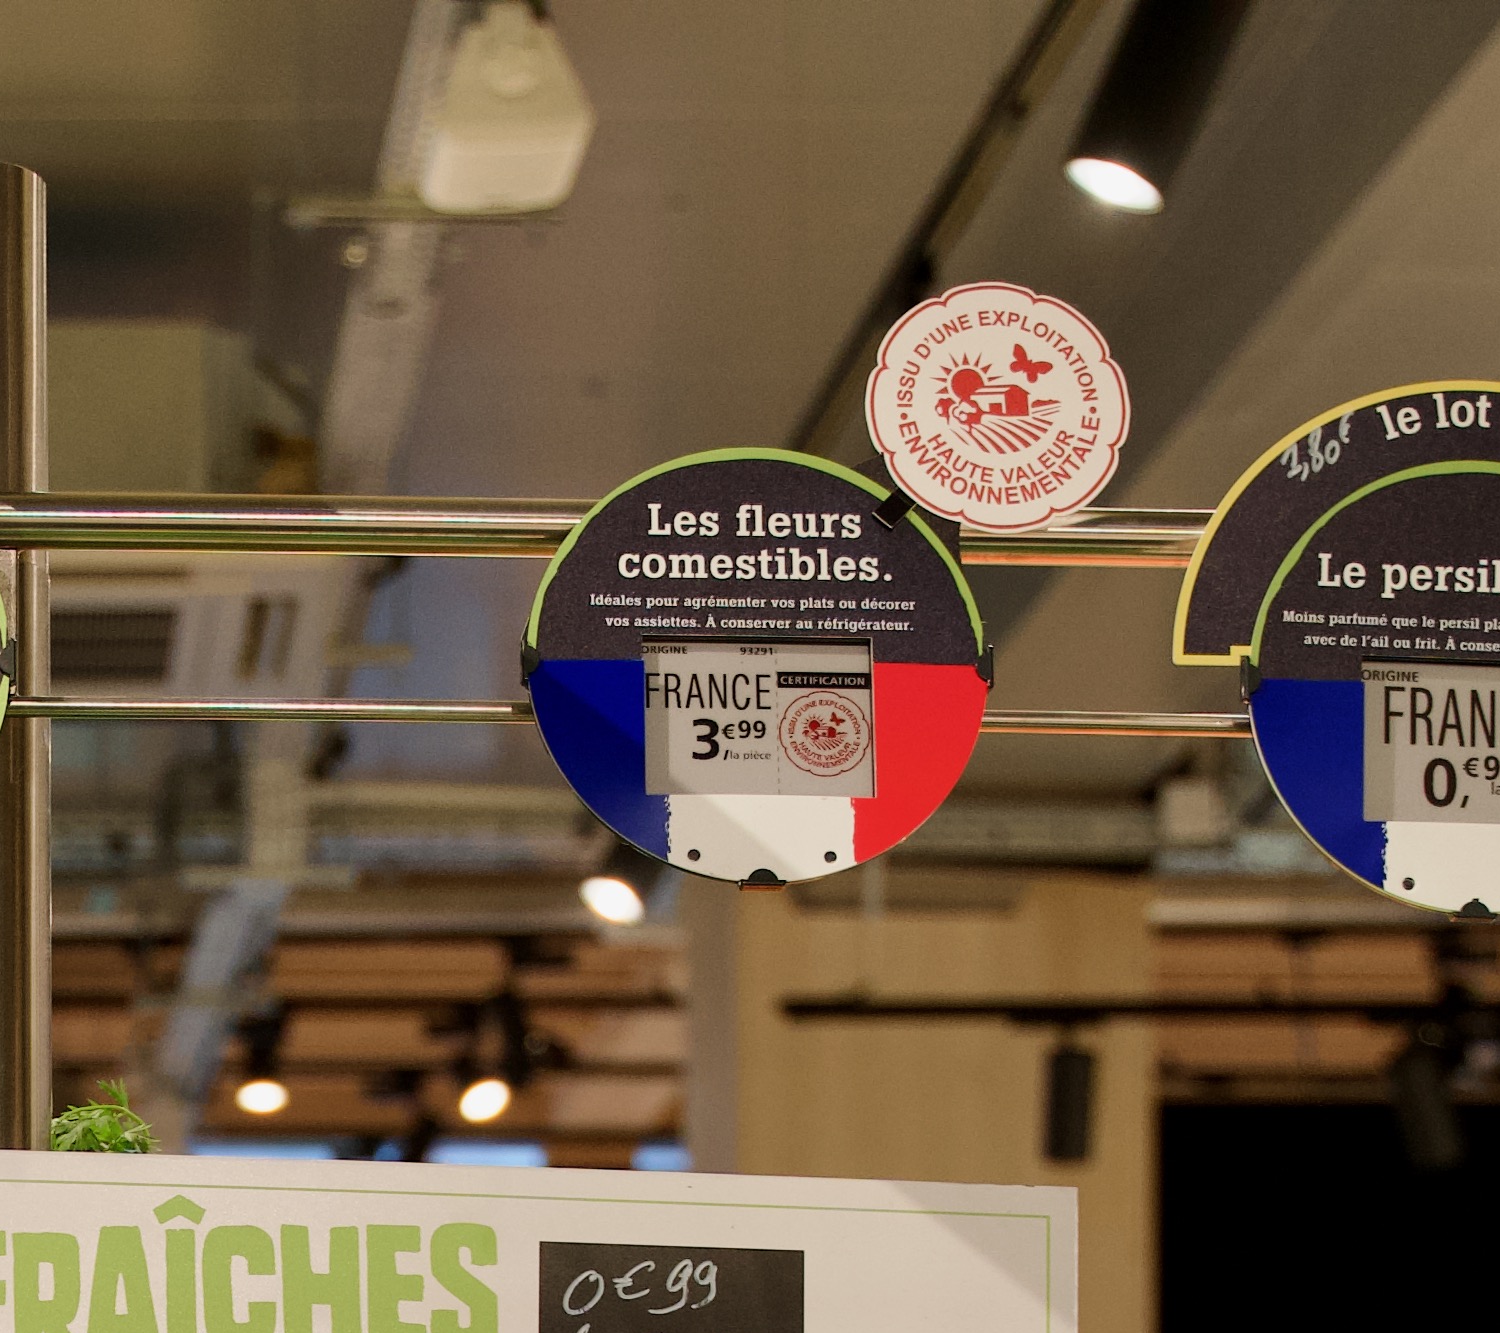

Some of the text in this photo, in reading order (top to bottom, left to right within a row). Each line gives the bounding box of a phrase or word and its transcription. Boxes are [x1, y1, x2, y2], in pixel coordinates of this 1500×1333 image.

[1376, 404, 1423, 441] le
[1432, 393, 1492, 429] lot
[647, 503, 862, 539] Les fleurs
[617, 547, 893, 583] comestibles.
[1317, 553, 1367, 590] Le
[645, 673, 771, 710] FRANCE
[780, 674, 866, 686] CERTIFICATION
[1361, 669, 1420, 684] ORIGINE
